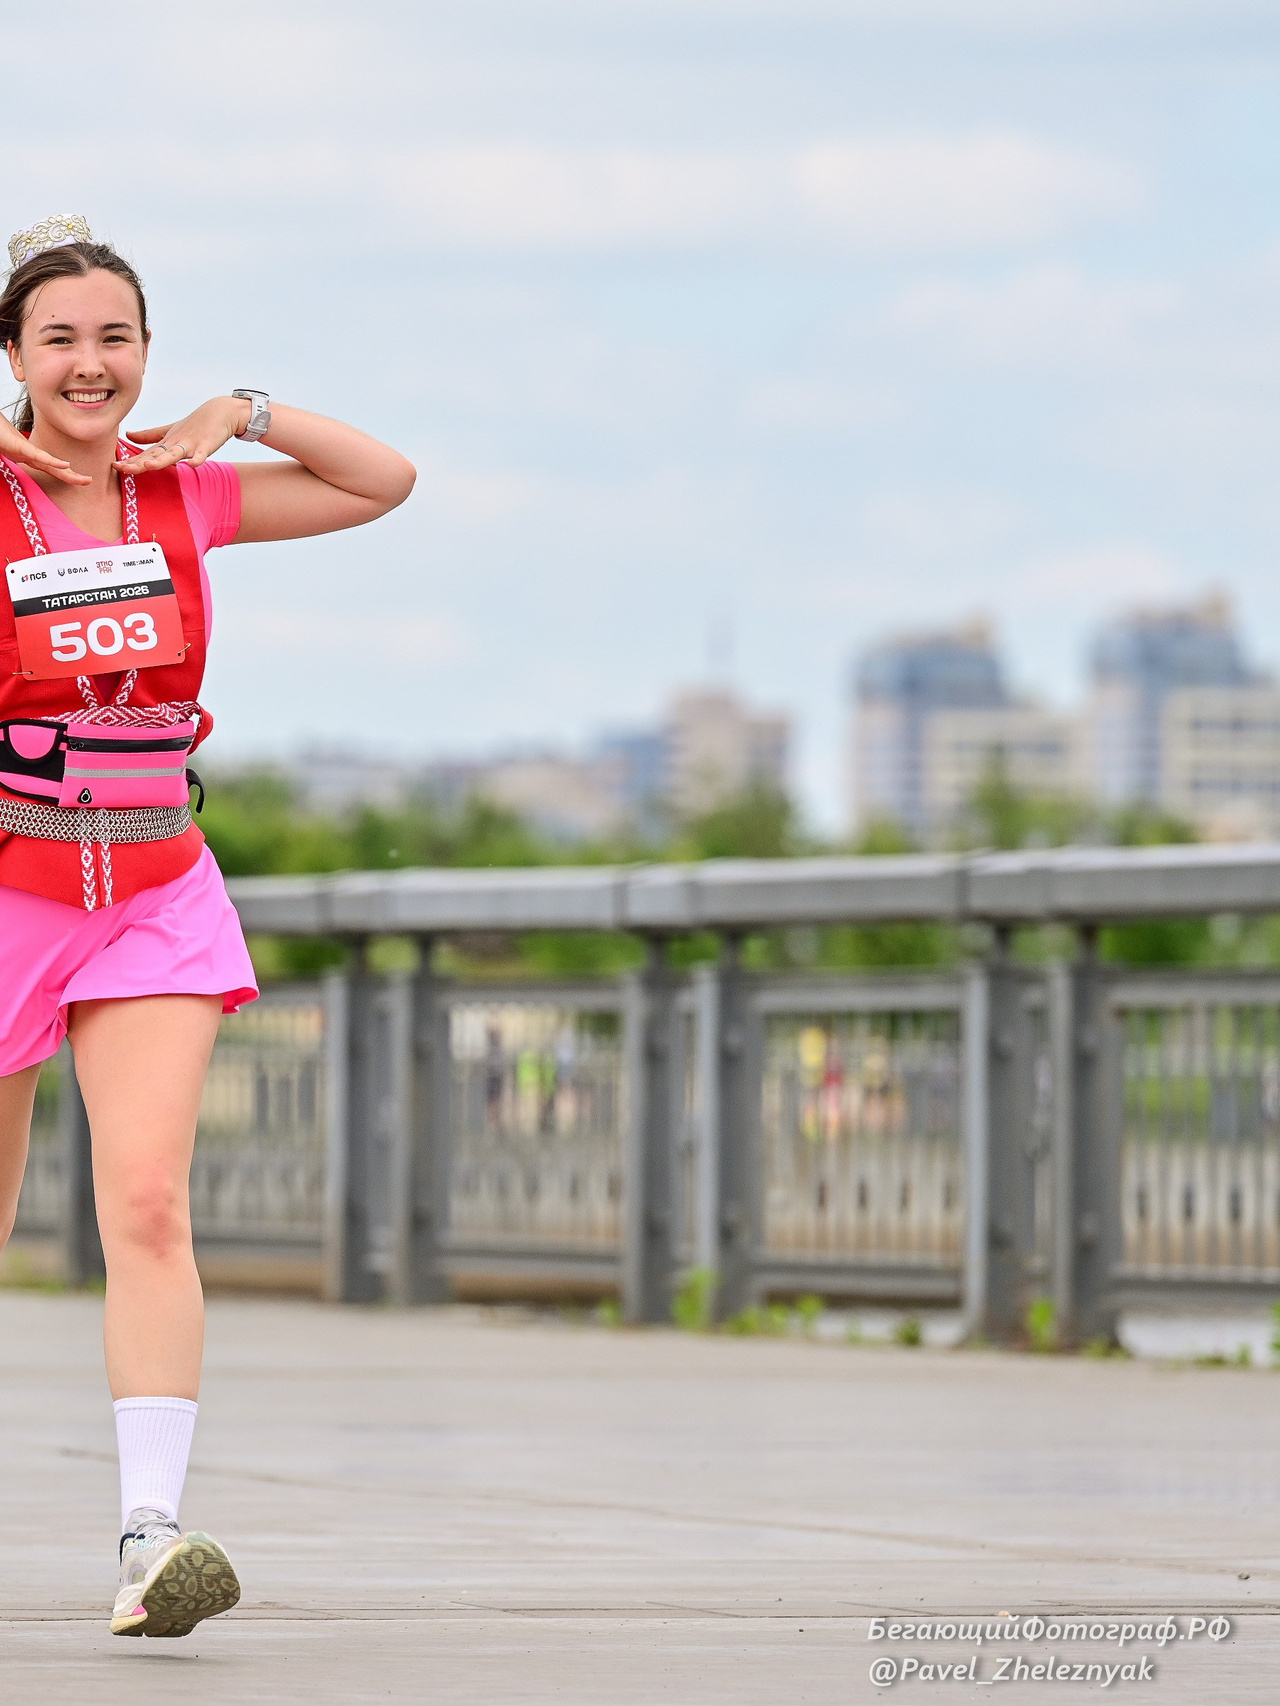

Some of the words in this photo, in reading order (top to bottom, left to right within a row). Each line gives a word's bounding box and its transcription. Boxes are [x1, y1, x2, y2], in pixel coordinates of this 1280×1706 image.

[29, 571, 47, 581] ПСБ
[67, 566, 89, 575] ВФЛА
[42, 589, 118, 609] ТАТАРСТАН
[119, 585, 150, 598] 2026
[49, 612, 158, 662] 503
